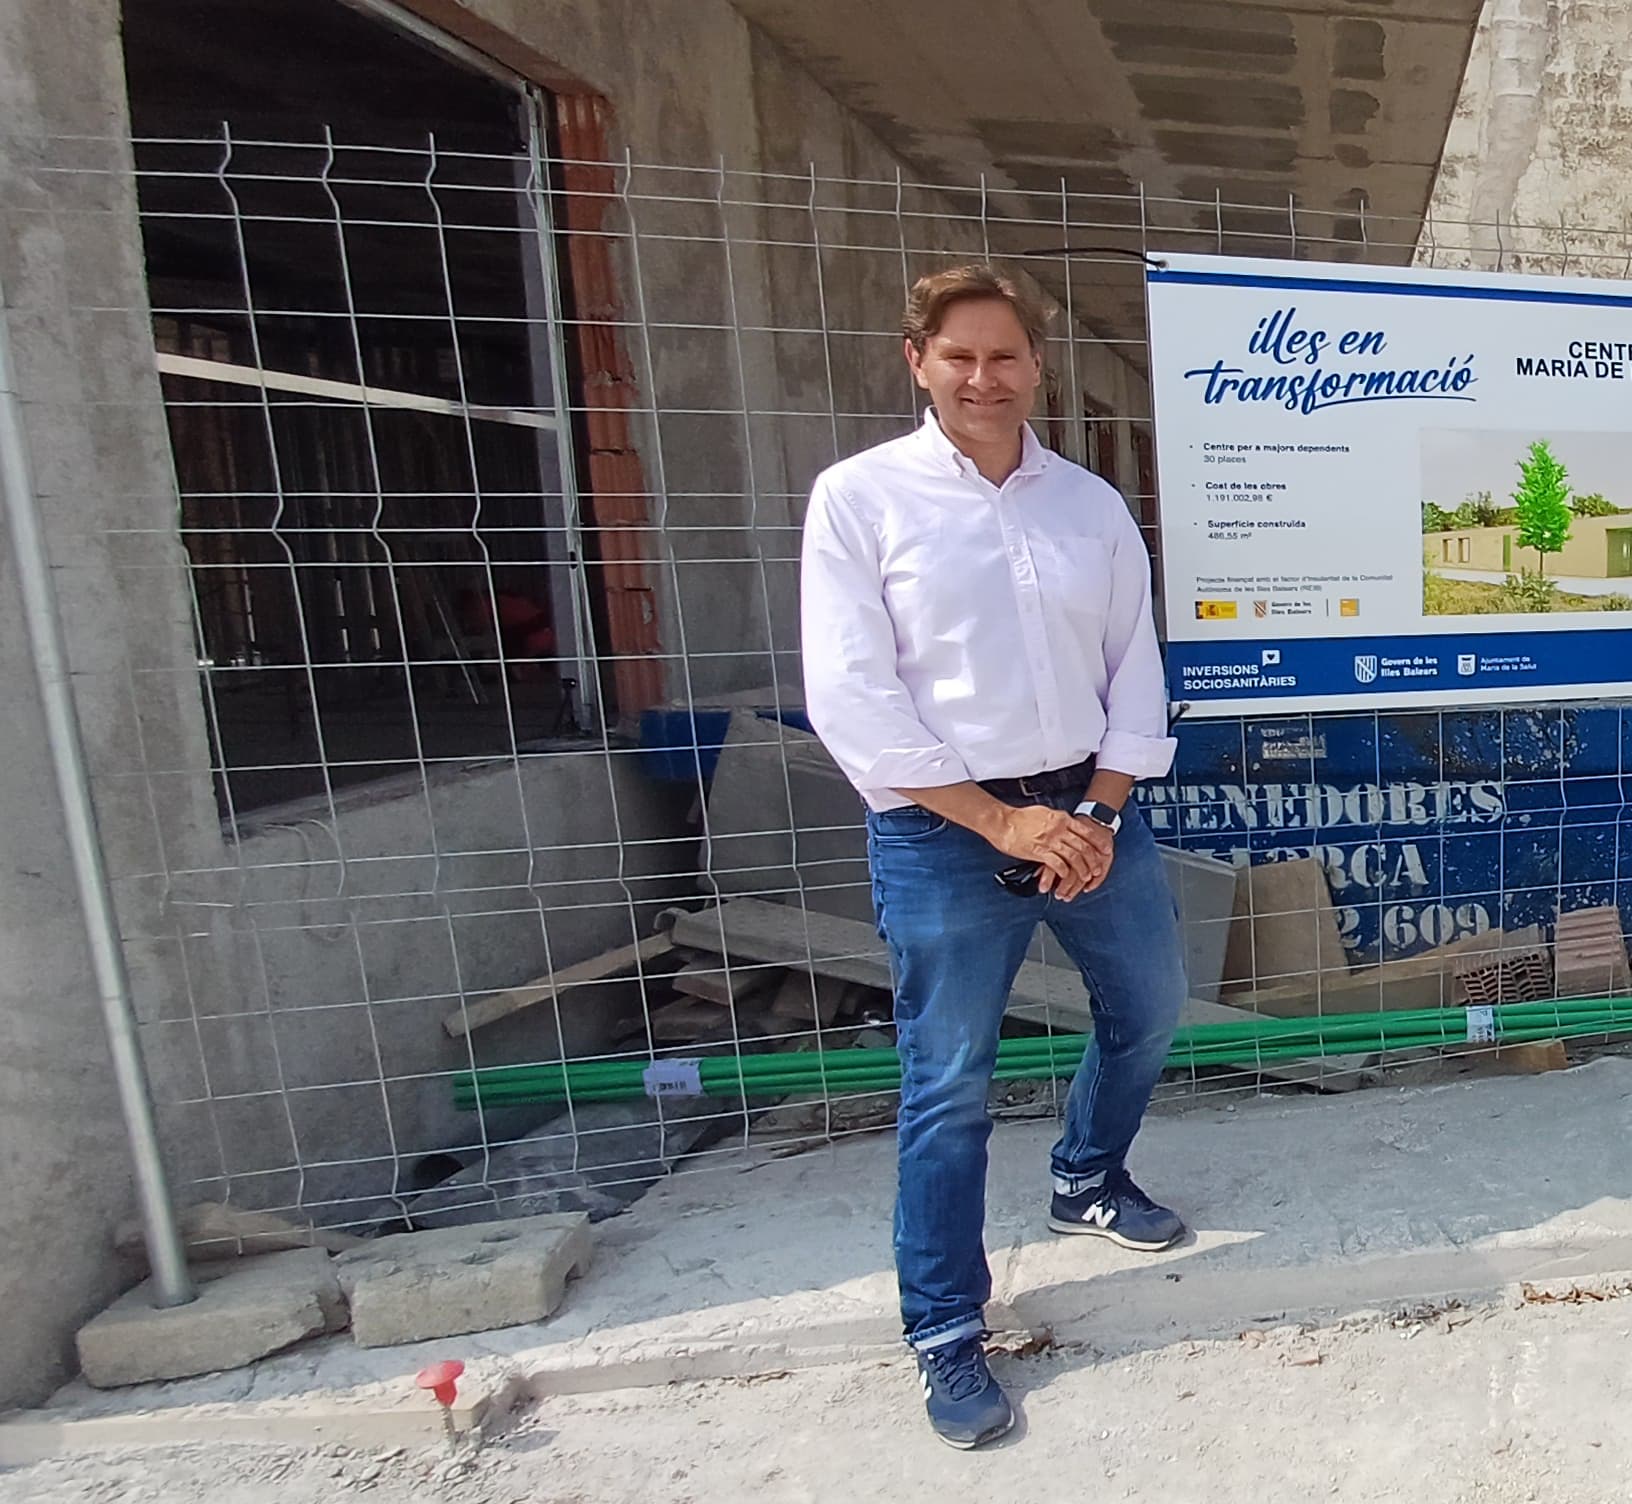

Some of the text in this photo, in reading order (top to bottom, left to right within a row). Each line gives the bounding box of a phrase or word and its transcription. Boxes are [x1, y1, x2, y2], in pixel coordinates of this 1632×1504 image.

[1248, 307, 1388, 364] illes en
[1516, 357, 1588, 378] MARIA
[1595, 362, 1625, 379] DE
[1184, 354, 1479, 415] transformació
[1203, 442, 1235, 451] Centre
[1237, 444, 1253, 454] per
[1263, 444, 1295, 454] majors
[1297, 444, 1350, 453] dependents
[1203, 455, 1247, 464] 30 places
[1205, 481, 1287, 490] Cost de les obres
[1266, 494, 1273, 502] €
[1381, 656, 1438, 666] Govern de les
[1183, 664, 1259, 677] INVERSIONS
[1381, 667, 1438, 677] Illes Balears
[1183, 674, 1297, 690] SOCIOSANITÀRIES
